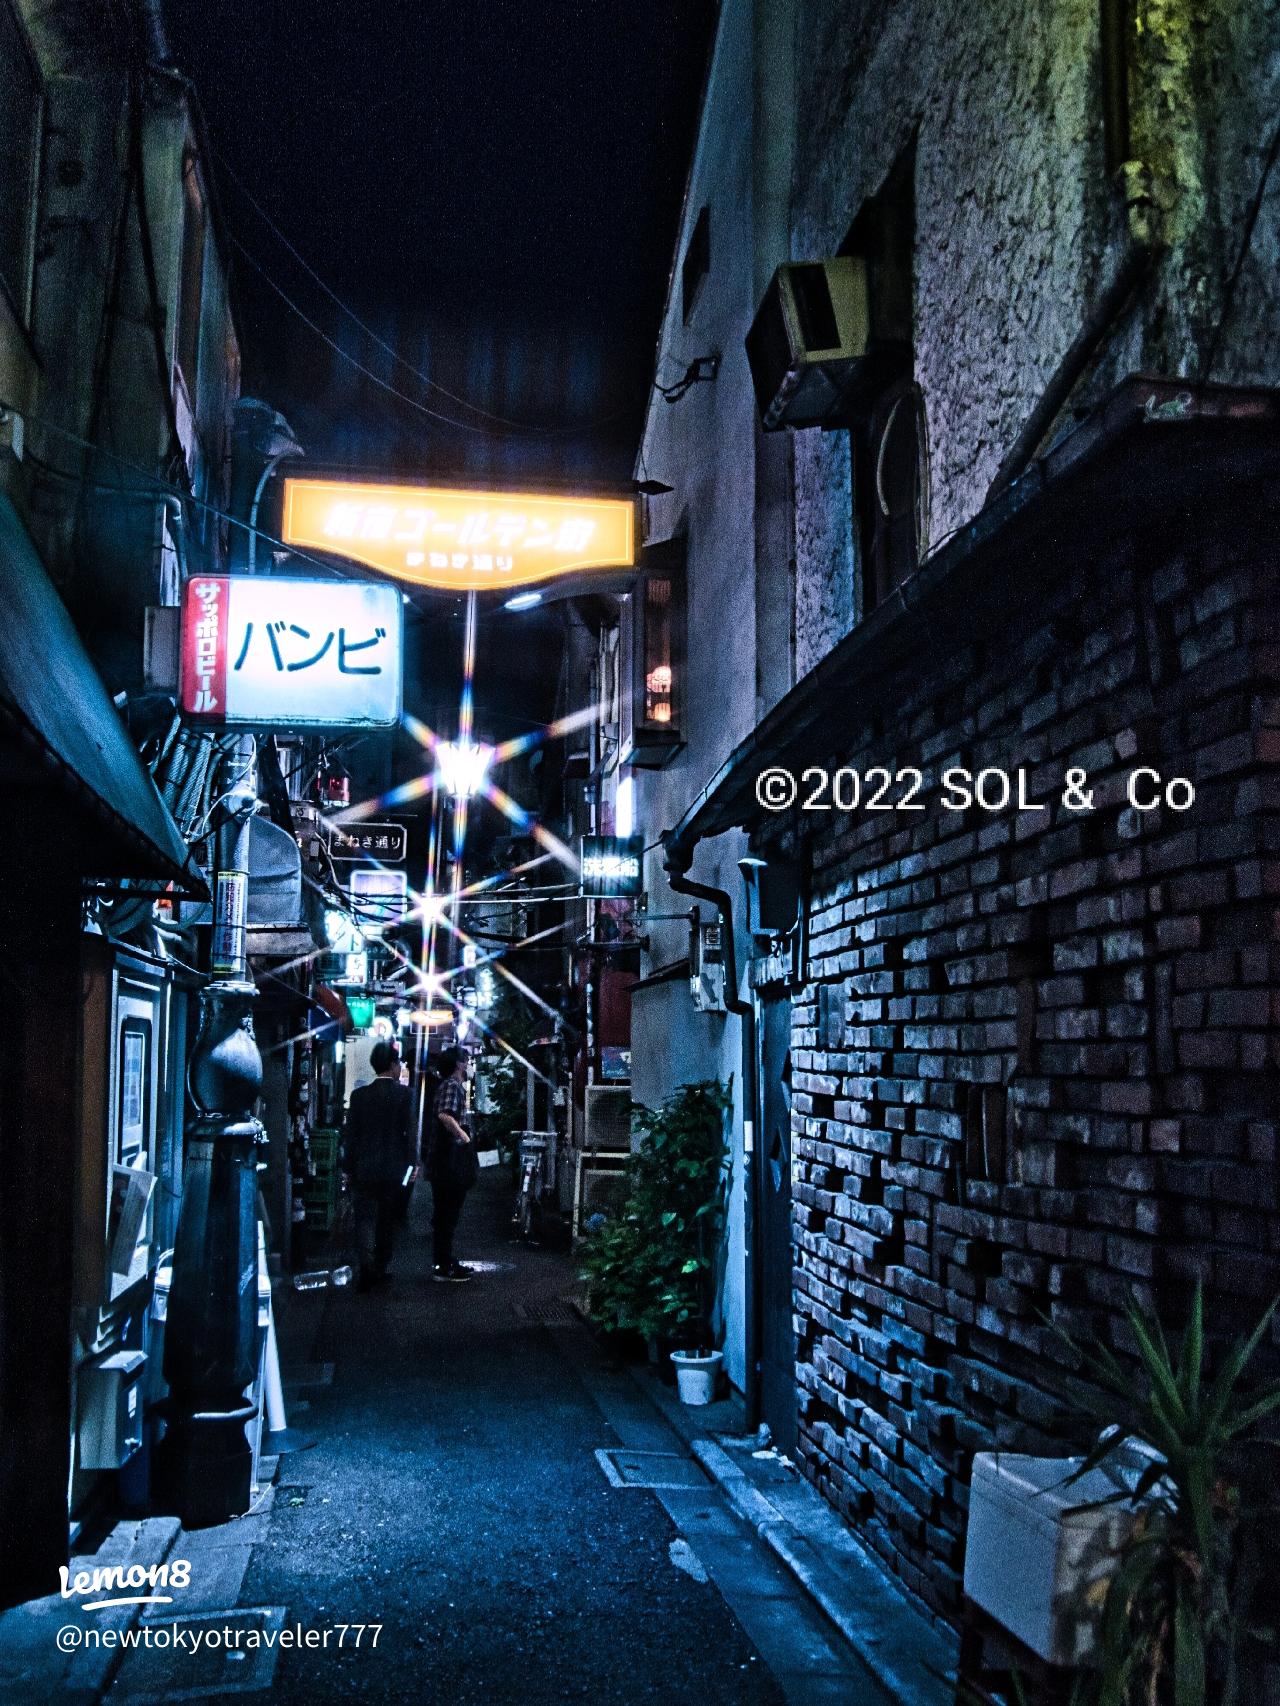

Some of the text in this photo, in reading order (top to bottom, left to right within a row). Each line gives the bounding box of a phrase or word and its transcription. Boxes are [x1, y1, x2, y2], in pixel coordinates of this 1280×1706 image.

[193, 582, 222, 713] サッポロビール
[233, 620, 386, 675] バンビ
[334, 835, 401, 849] まねき通り
